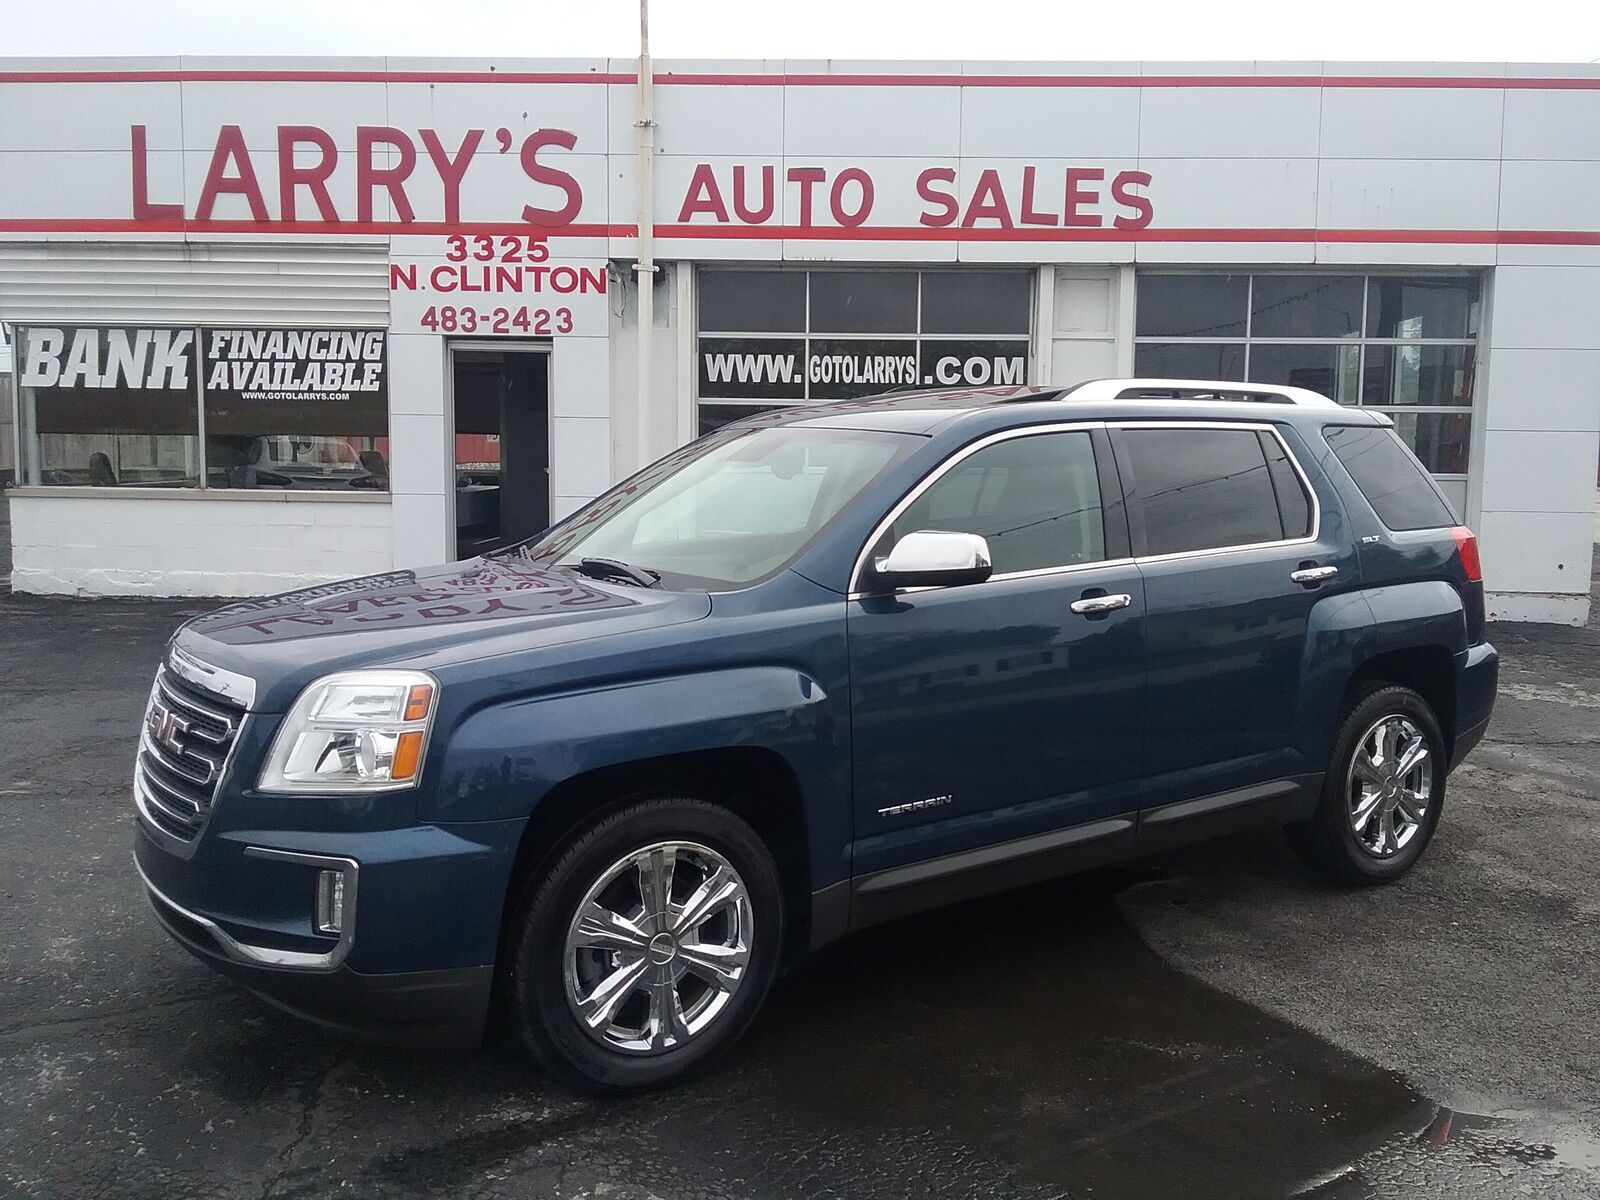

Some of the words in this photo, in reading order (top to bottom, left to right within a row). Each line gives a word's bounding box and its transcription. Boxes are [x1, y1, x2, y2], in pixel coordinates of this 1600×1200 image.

[130, 124, 584, 228] LARRY'S
[677, 164, 874, 228] AUTO
[916, 166, 1154, 231] SALES
[446, 235, 550, 263] 3325
[420, 305, 573, 335] 483-2423
[20, 327, 195, 390] BANK
[207, 330, 385, 361] FINANCING
[207, 361, 383, 392] AVAILABLE
[241, 391, 350, 401] WWW.GOTOLARRYS.COM
[147, 703, 190, 755] GMC
[878, 794, 953, 817] TERRAIN
